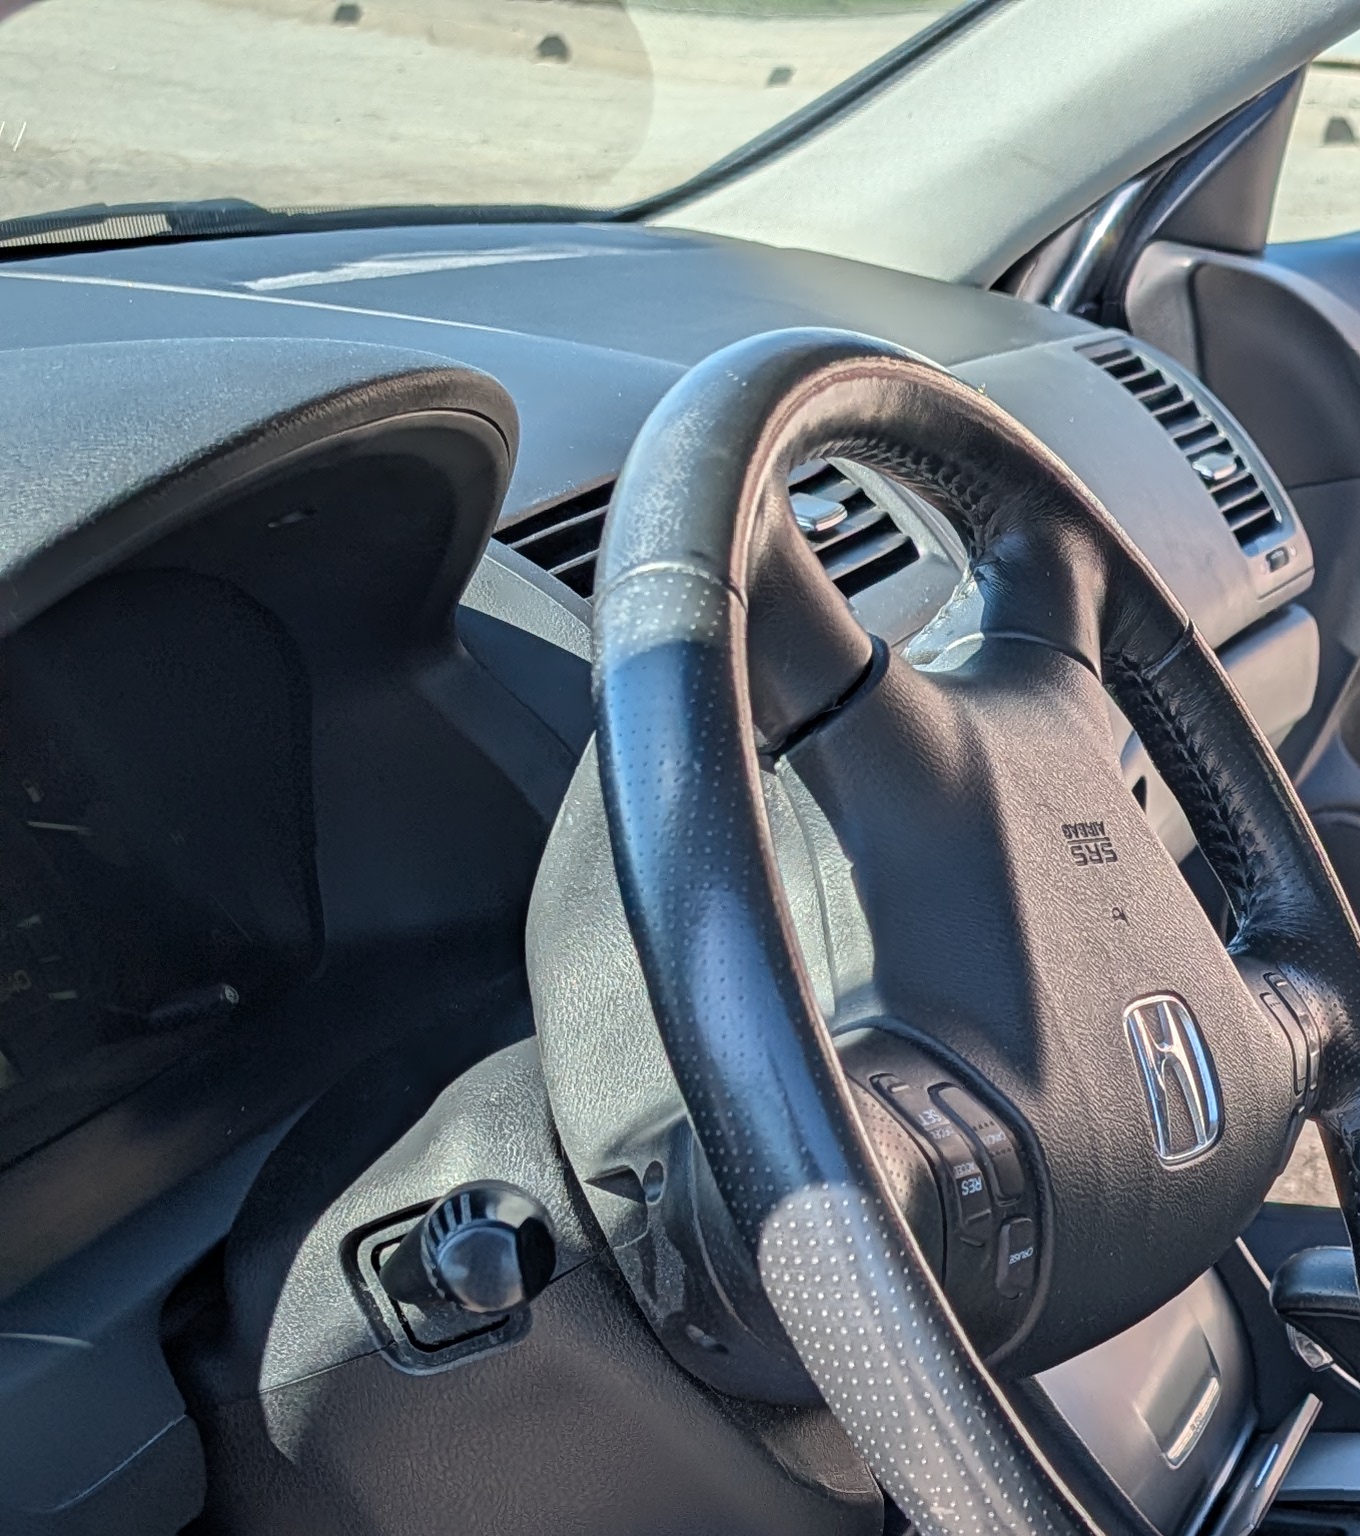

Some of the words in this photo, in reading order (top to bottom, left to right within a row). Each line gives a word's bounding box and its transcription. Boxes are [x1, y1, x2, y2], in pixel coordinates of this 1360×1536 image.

[1061, 821, 1106, 840] AIRBAG
[1069, 842, 1118, 867] SRS
[918, 1109, 942, 1126] SET
[960, 1176, 984, 1197] RES
[1008, 1247, 1034, 1265] CRUISE
